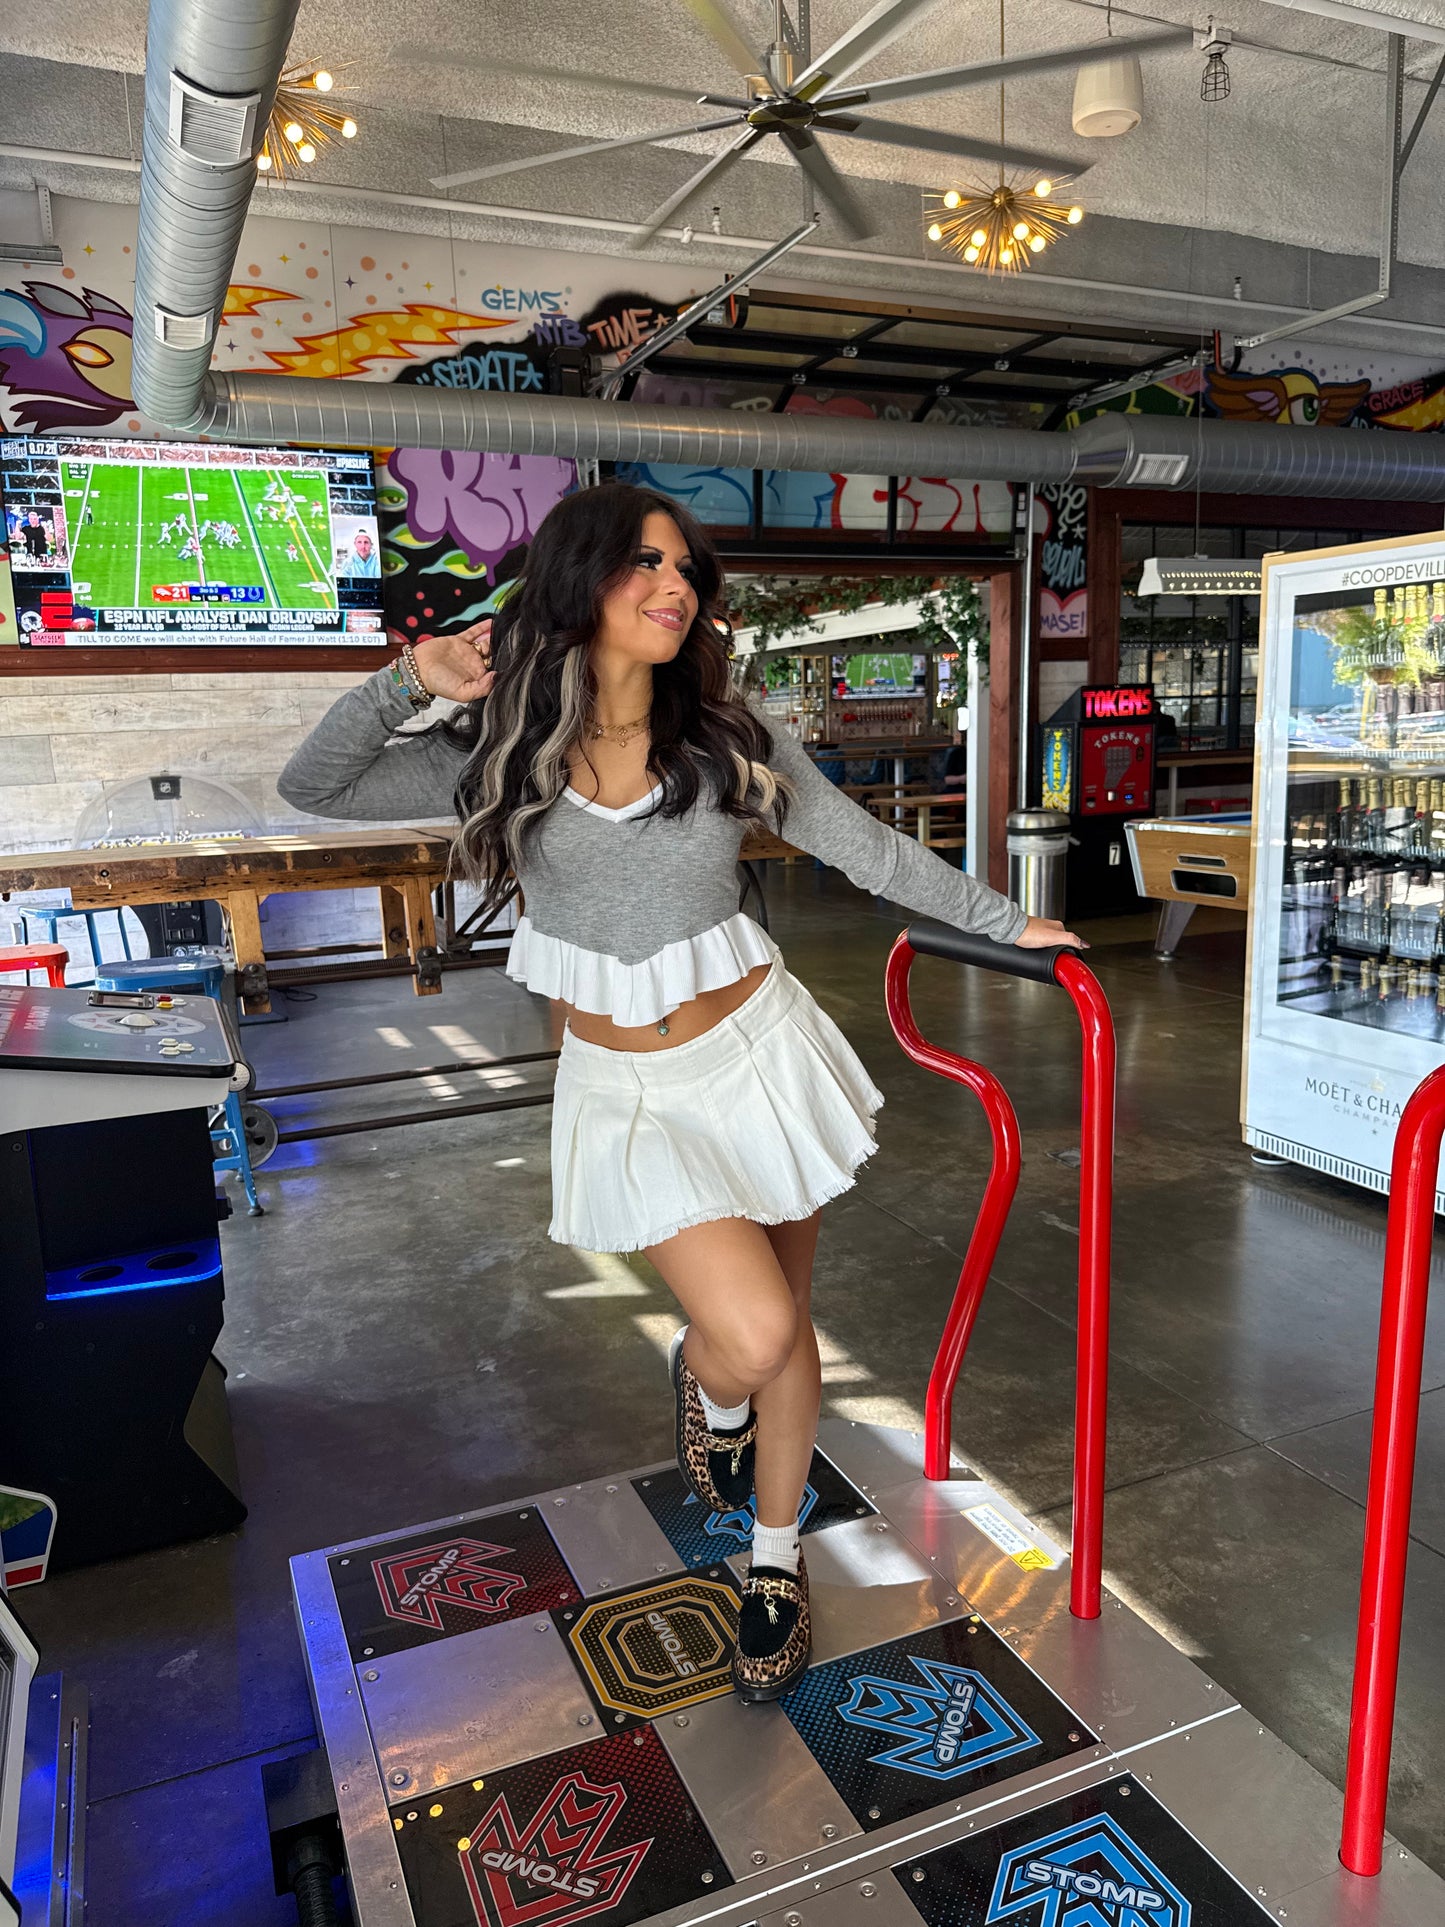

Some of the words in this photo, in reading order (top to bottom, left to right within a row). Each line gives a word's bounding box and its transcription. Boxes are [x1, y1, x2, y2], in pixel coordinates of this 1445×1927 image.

[481, 288, 562, 312] GEMS
[588, 309, 653, 347] TIME
[1368, 380, 1425, 412] GRACE
[1341, 562, 1445, 587] #COOPDEVILL
[172, 587, 187, 598] 21
[231, 587, 246, 598] 13
[104, 610, 144, 624] ESPN
[146, 610, 174, 624] NFL
[176, 610, 237, 624] ANALYST
[239, 611, 268, 624] DAN
[270, 611, 340, 625] ORLOVSKY
[123, 623, 140, 631] YEAR
[141, 623, 154, 631] NFL
[181, 623, 210, 631] CO-HOST
[233, 623, 246, 631] LIVE
[100, 635, 111, 643] TO
[114, 635, 141, 643] COME
[159, 635, 174, 643] will
[177, 635, 196, 643] chat
[198, 635, 216, 643] with
[220, 635, 247, 643] Future
[250, 635, 266, 643] Hall
[280, 635, 305, 643] Famer
[316, 635, 336, 643] Watt
[1083, 689, 1152, 718] TOKENS
[1094, 731, 1140, 749] TOKENS
[1053, 731, 1062, 791] TOKENS
[1305, 1077, 1351, 1102] MOËT
[1354, 1094, 1363, 1107] &
[400, 1549, 461, 1607] STOMP
[647, 1611, 697, 1677] STOMP
[936, 1683, 974, 1762] STOMP
[482, 1851, 600, 1898] STOMP
[1027, 1861, 1163, 1909] STOMP
